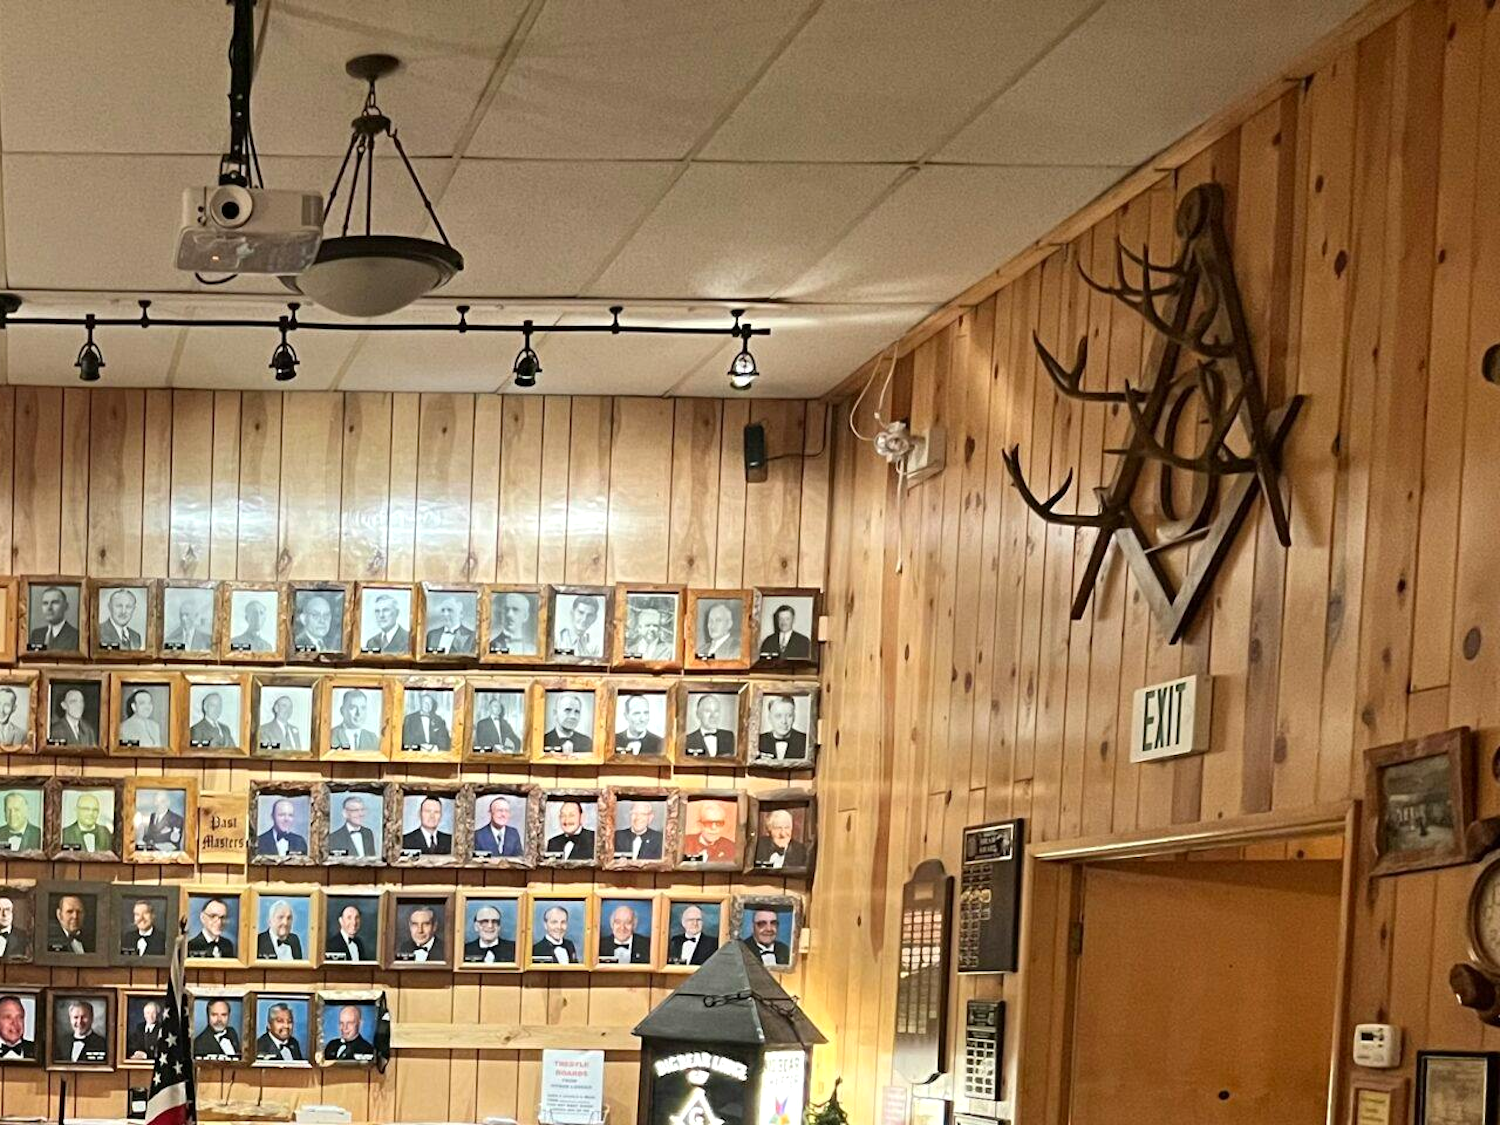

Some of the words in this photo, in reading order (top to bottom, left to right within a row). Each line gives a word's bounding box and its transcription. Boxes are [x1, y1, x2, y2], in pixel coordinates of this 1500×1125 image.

[1142, 682, 1186, 751] EXIT
[210, 815, 237, 831] Past
[202, 834, 244, 849] Masters
[677, 1052, 711, 1070] BEAR
